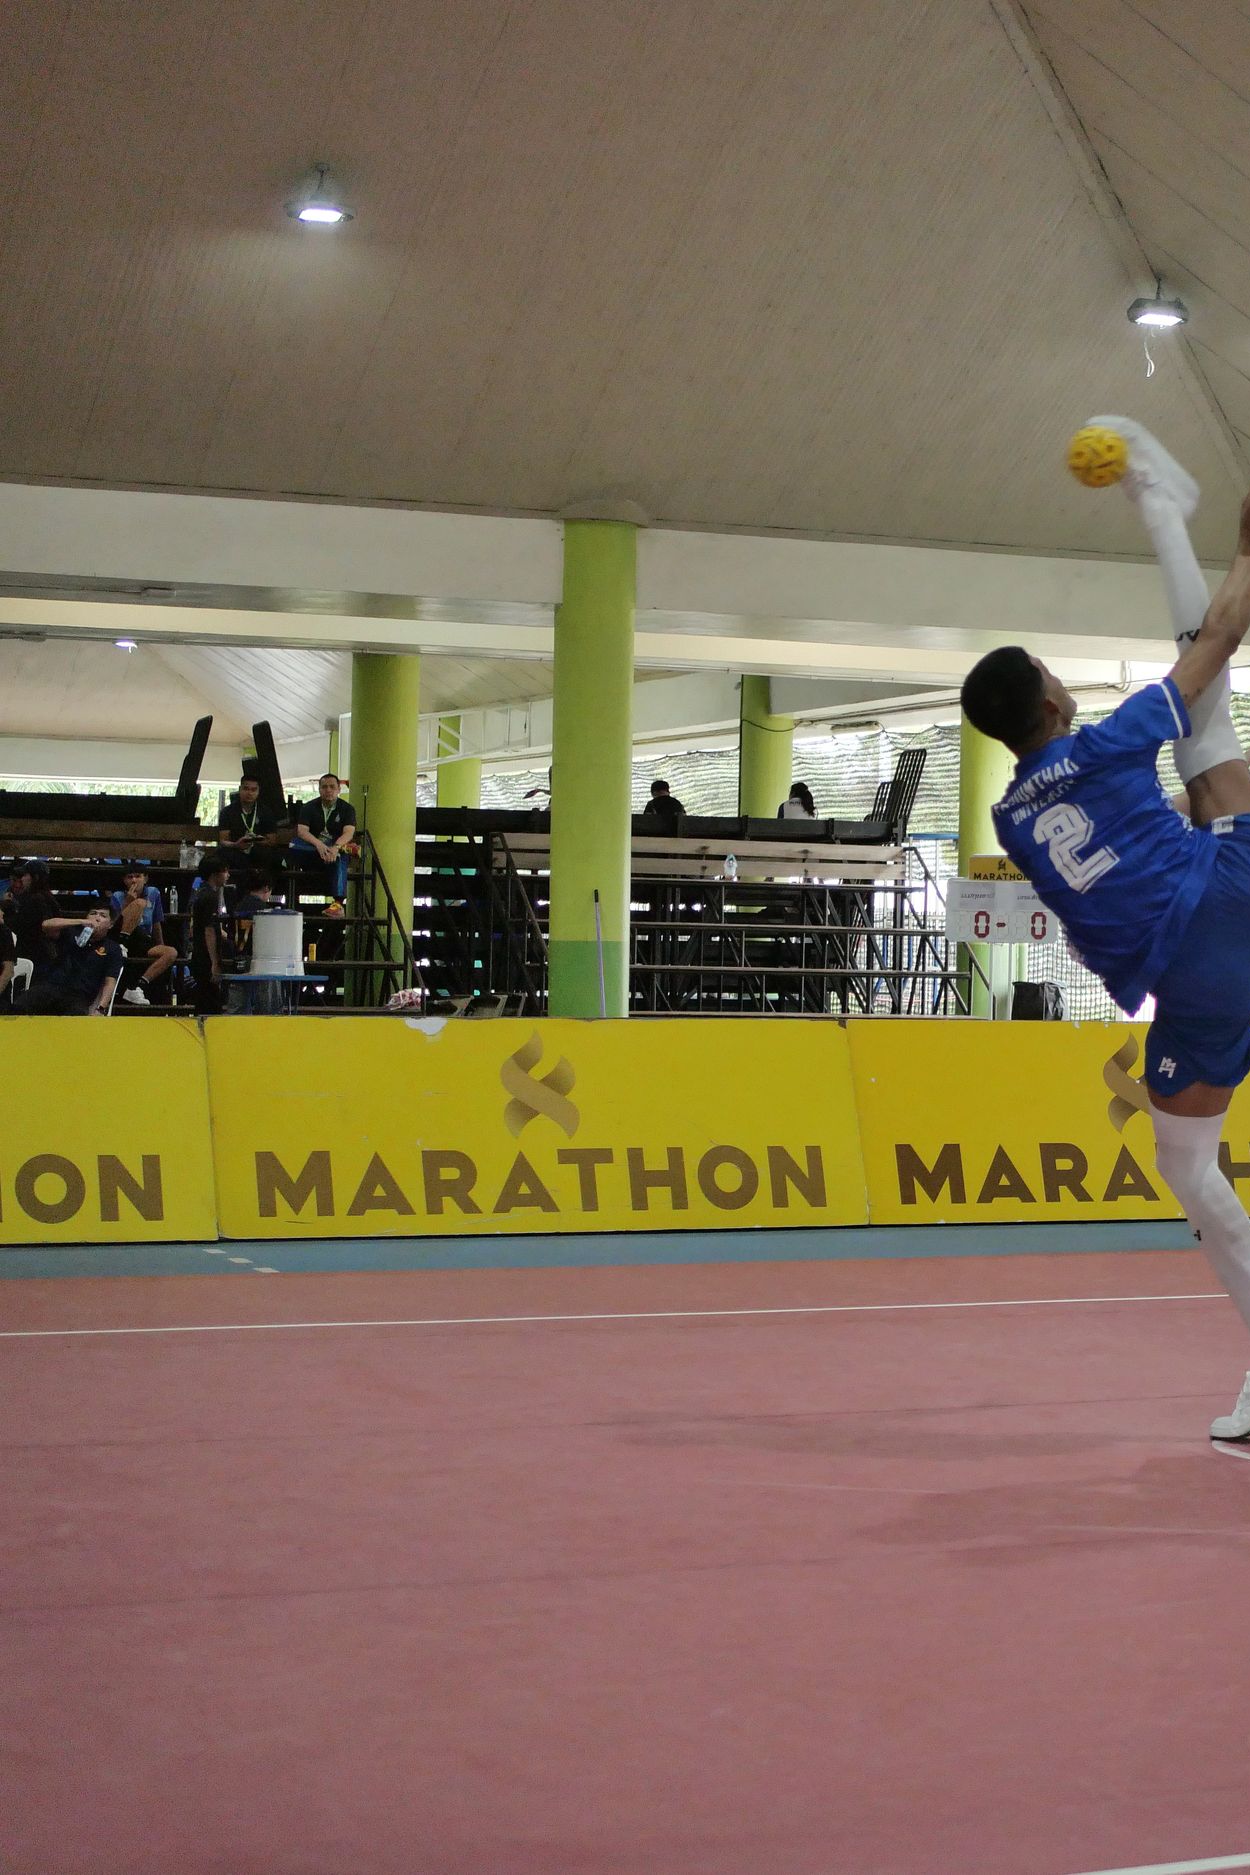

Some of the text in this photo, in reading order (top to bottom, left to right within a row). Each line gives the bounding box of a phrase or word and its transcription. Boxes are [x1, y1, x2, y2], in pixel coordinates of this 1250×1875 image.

[1032, 803, 1120, 894] 2
[0, 1153, 165, 1225] ON
[253, 1144, 827, 1218] MARATHON
